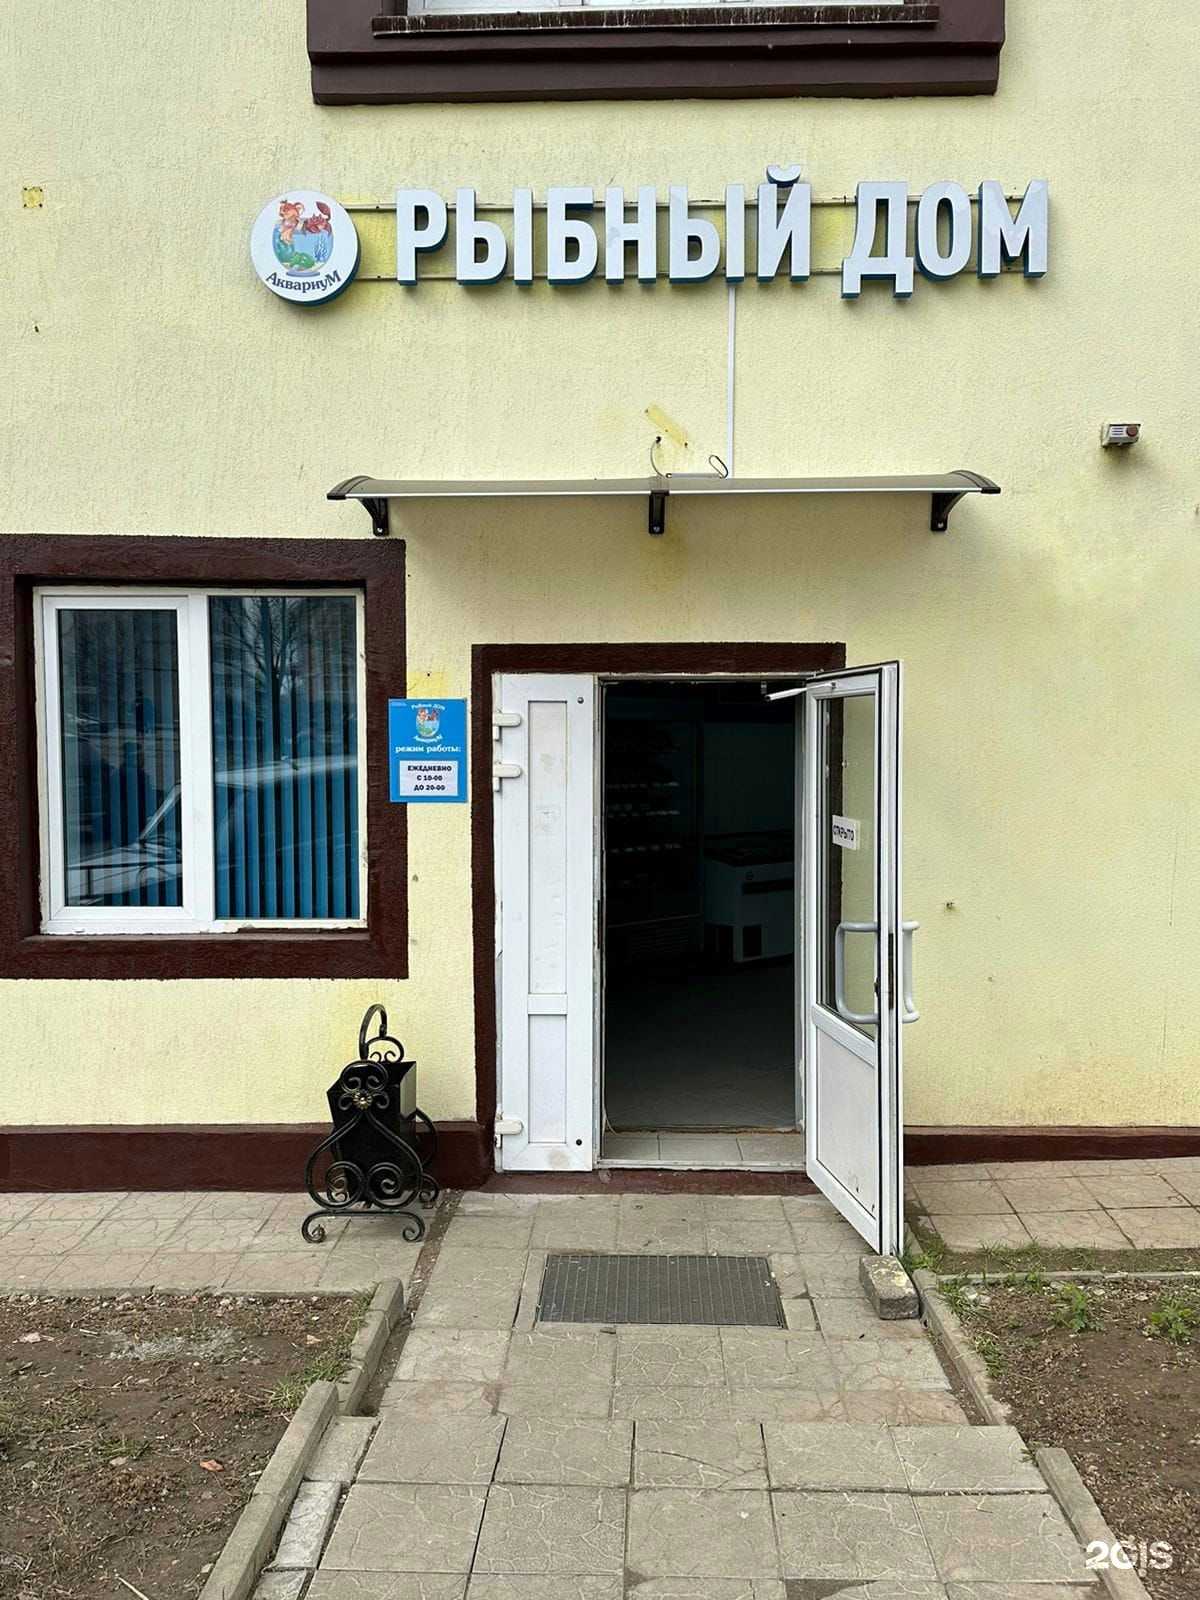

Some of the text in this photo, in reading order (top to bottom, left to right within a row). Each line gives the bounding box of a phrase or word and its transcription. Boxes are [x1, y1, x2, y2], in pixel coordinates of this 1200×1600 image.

[396, 165, 1049, 298] РЫБНЫЙ ДОМ
[395, 745, 424, 753] режим
